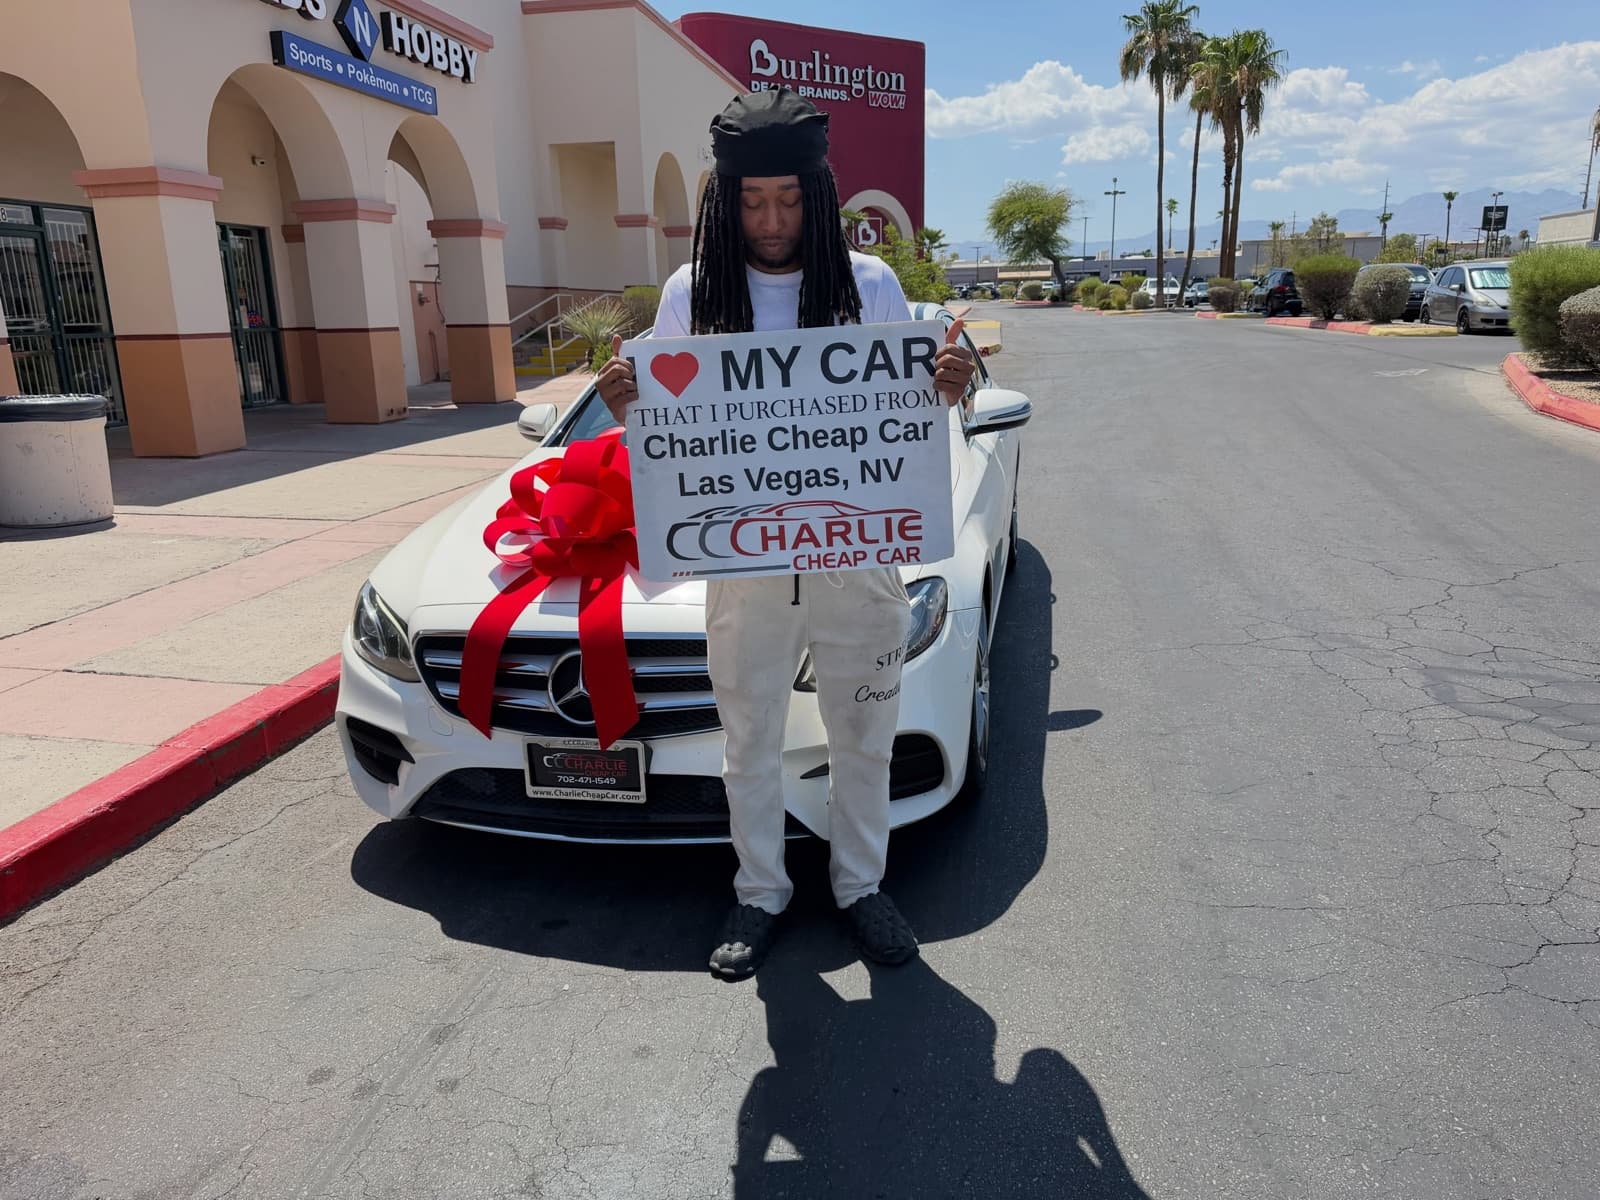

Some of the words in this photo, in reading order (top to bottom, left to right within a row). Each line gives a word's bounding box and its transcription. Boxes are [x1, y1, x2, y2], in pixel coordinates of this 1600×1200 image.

[353, 6, 372, 48] N
[390, 11, 479, 84] HOBBY
[289, 42, 333, 73] Sports
[410, 85, 433, 106] TCG
[750, 39, 906, 98] Burlington
[868, 90, 907, 110] WOW!
[720, 345, 802, 393] MY
[819, 336, 938, 385] CAR
[634, 403, 704, 428] THAT
[710, 404, 719, 423] I
[726, 393, 868, 422] PURCHASED
[874, 388, 942, 412] FROM
[643, 428, 758, 460] Charlie
[766, 423, 868, 453] Cheap
[878, 418, 934, 445] Car
[678, 471, 736, 498] Las
[743, 466, 849, 497] Vegas,
[859, 457, 905, 485] NV
[792, 550, 868, 571] CHEAP
[875, 546, 921, 565] CAR
[532, 789, 640, 800] www.CharlieCheapCar.com
[556, 775, 617, 785] 702-471-1549
